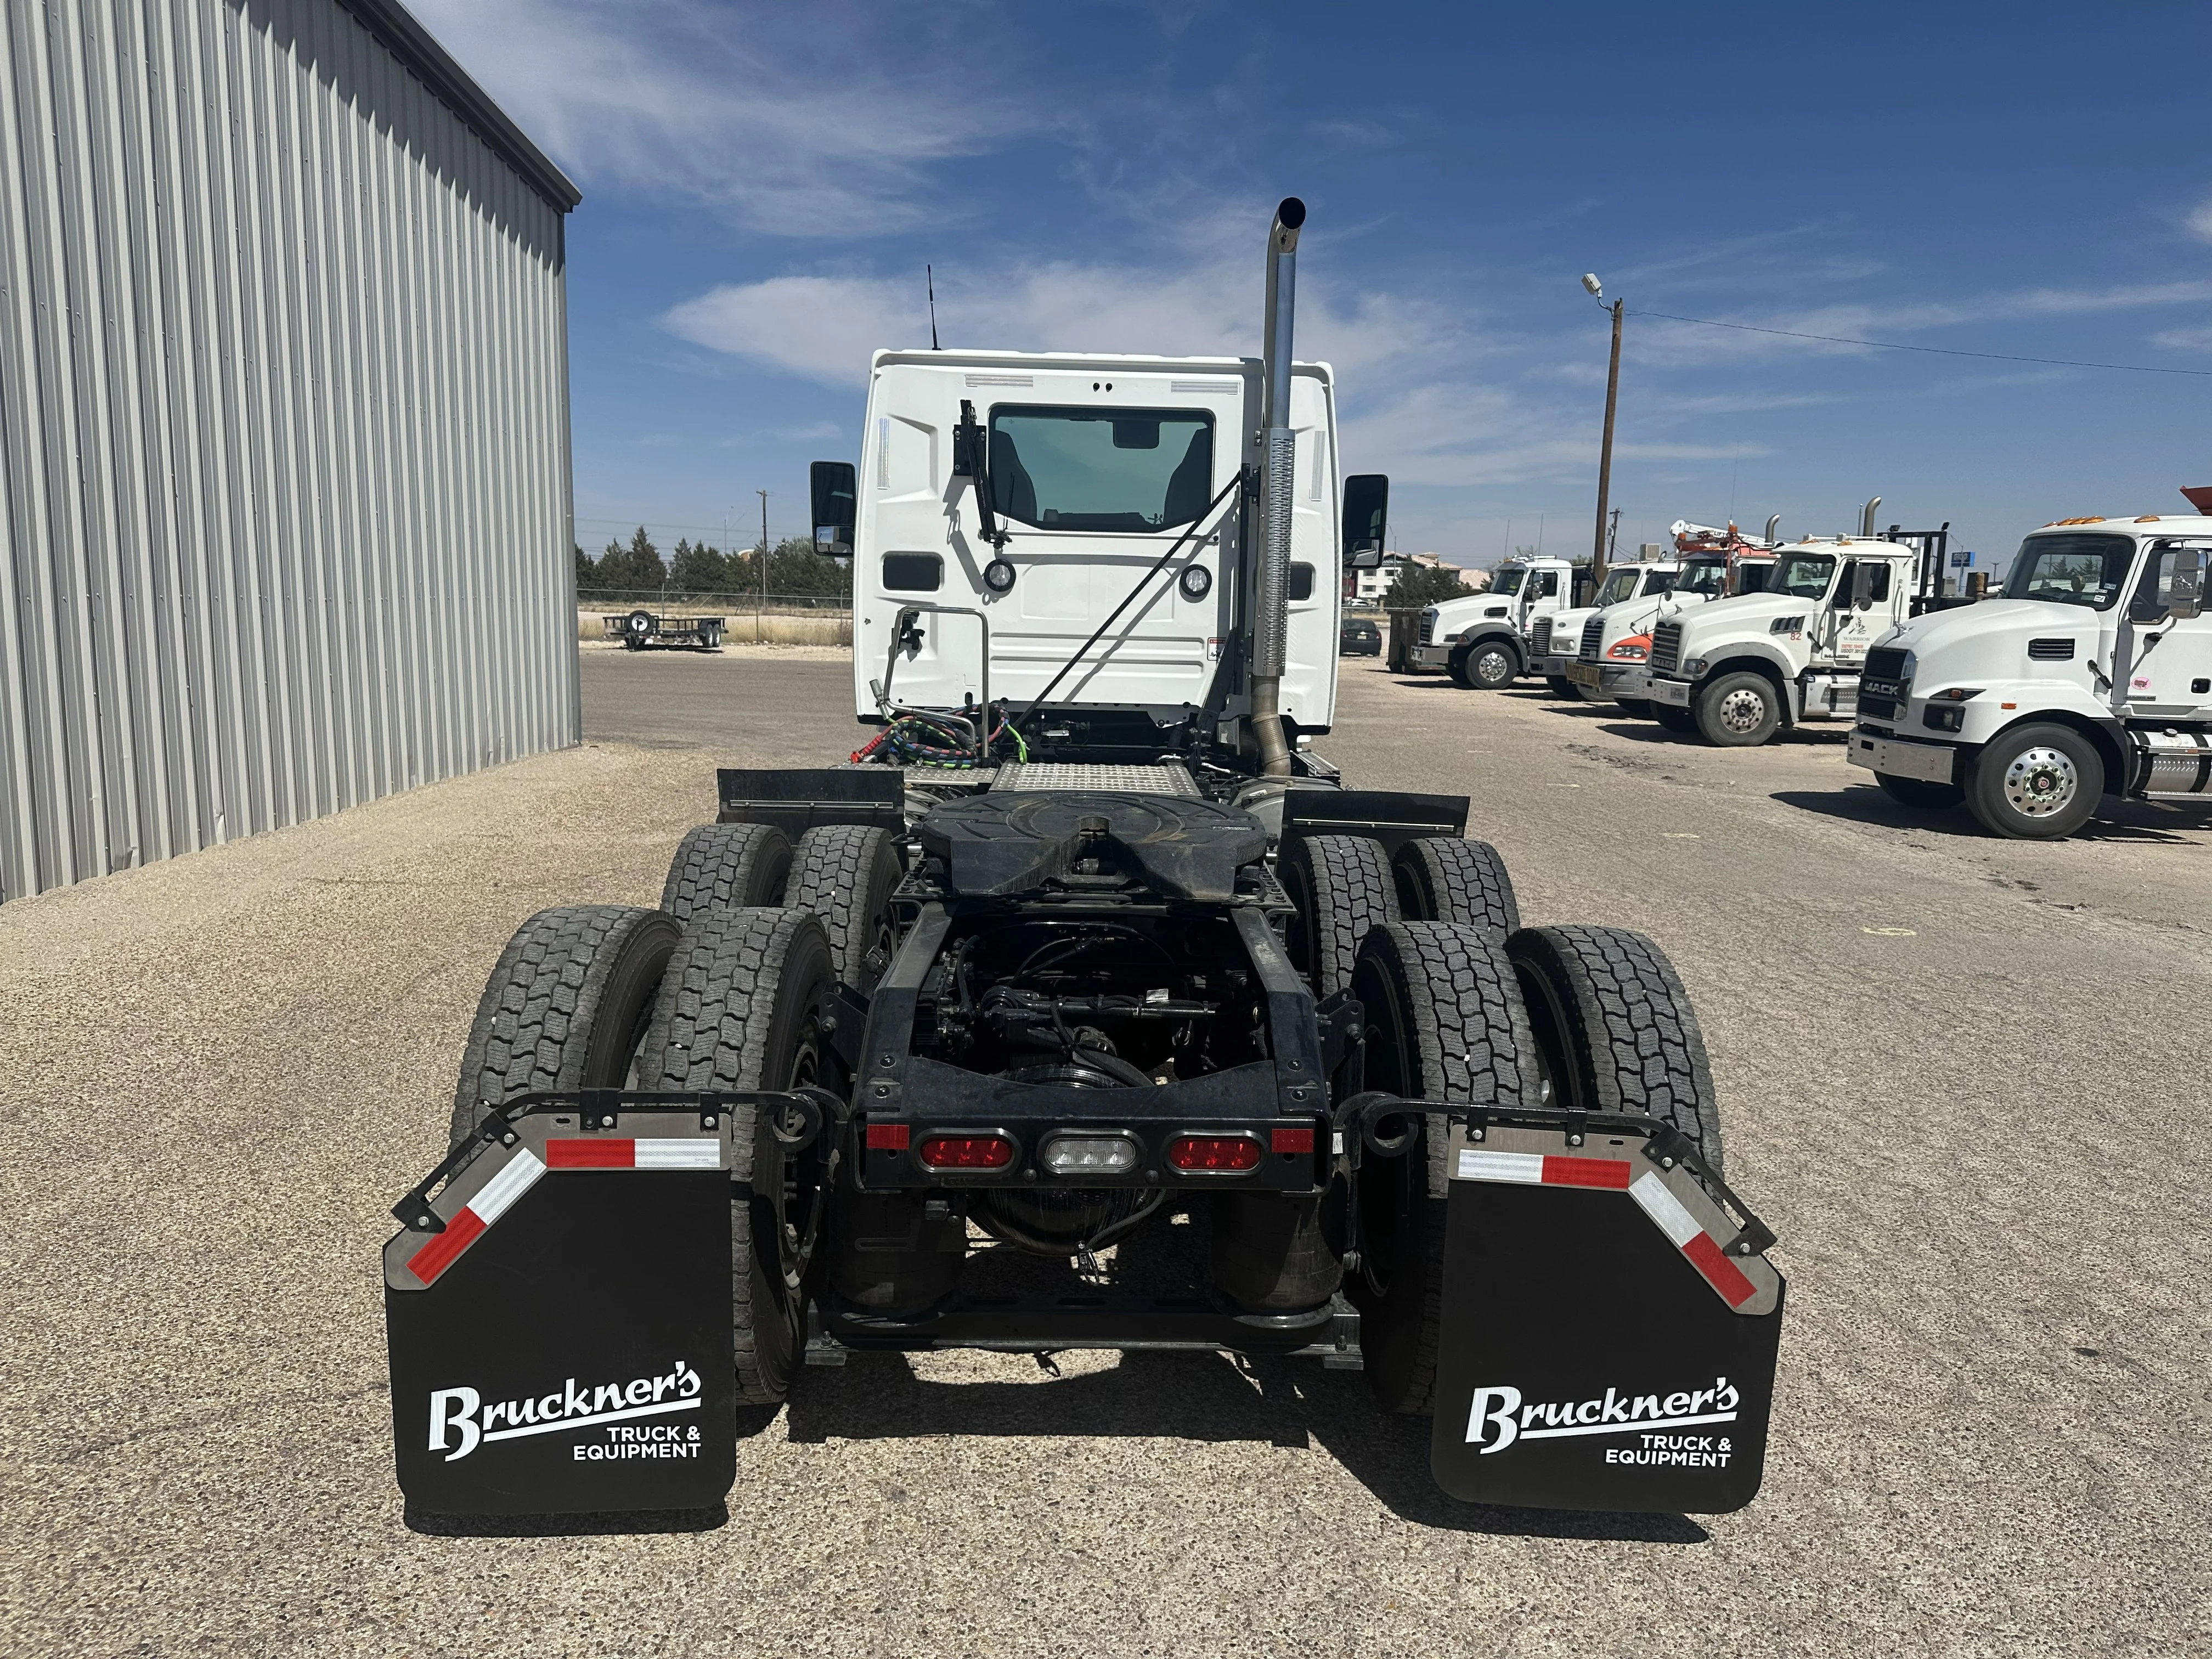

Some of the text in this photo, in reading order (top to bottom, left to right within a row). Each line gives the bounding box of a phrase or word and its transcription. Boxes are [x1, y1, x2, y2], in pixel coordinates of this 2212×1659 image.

[1865, 681, 1899, 695] MACK
[428, 1361, 701, 1462] Bruckner's
[1465, 1377, 1739, 1454] Bruckner's
[607, 1426, 701, 1442] TRUCK &
[574, 1443, 701, 1460] EQUIPMENT
[1641, 1435, 1731, 1452] TRUCK &
[1606, 1449, 1731, 1467] EQUIPMENT
